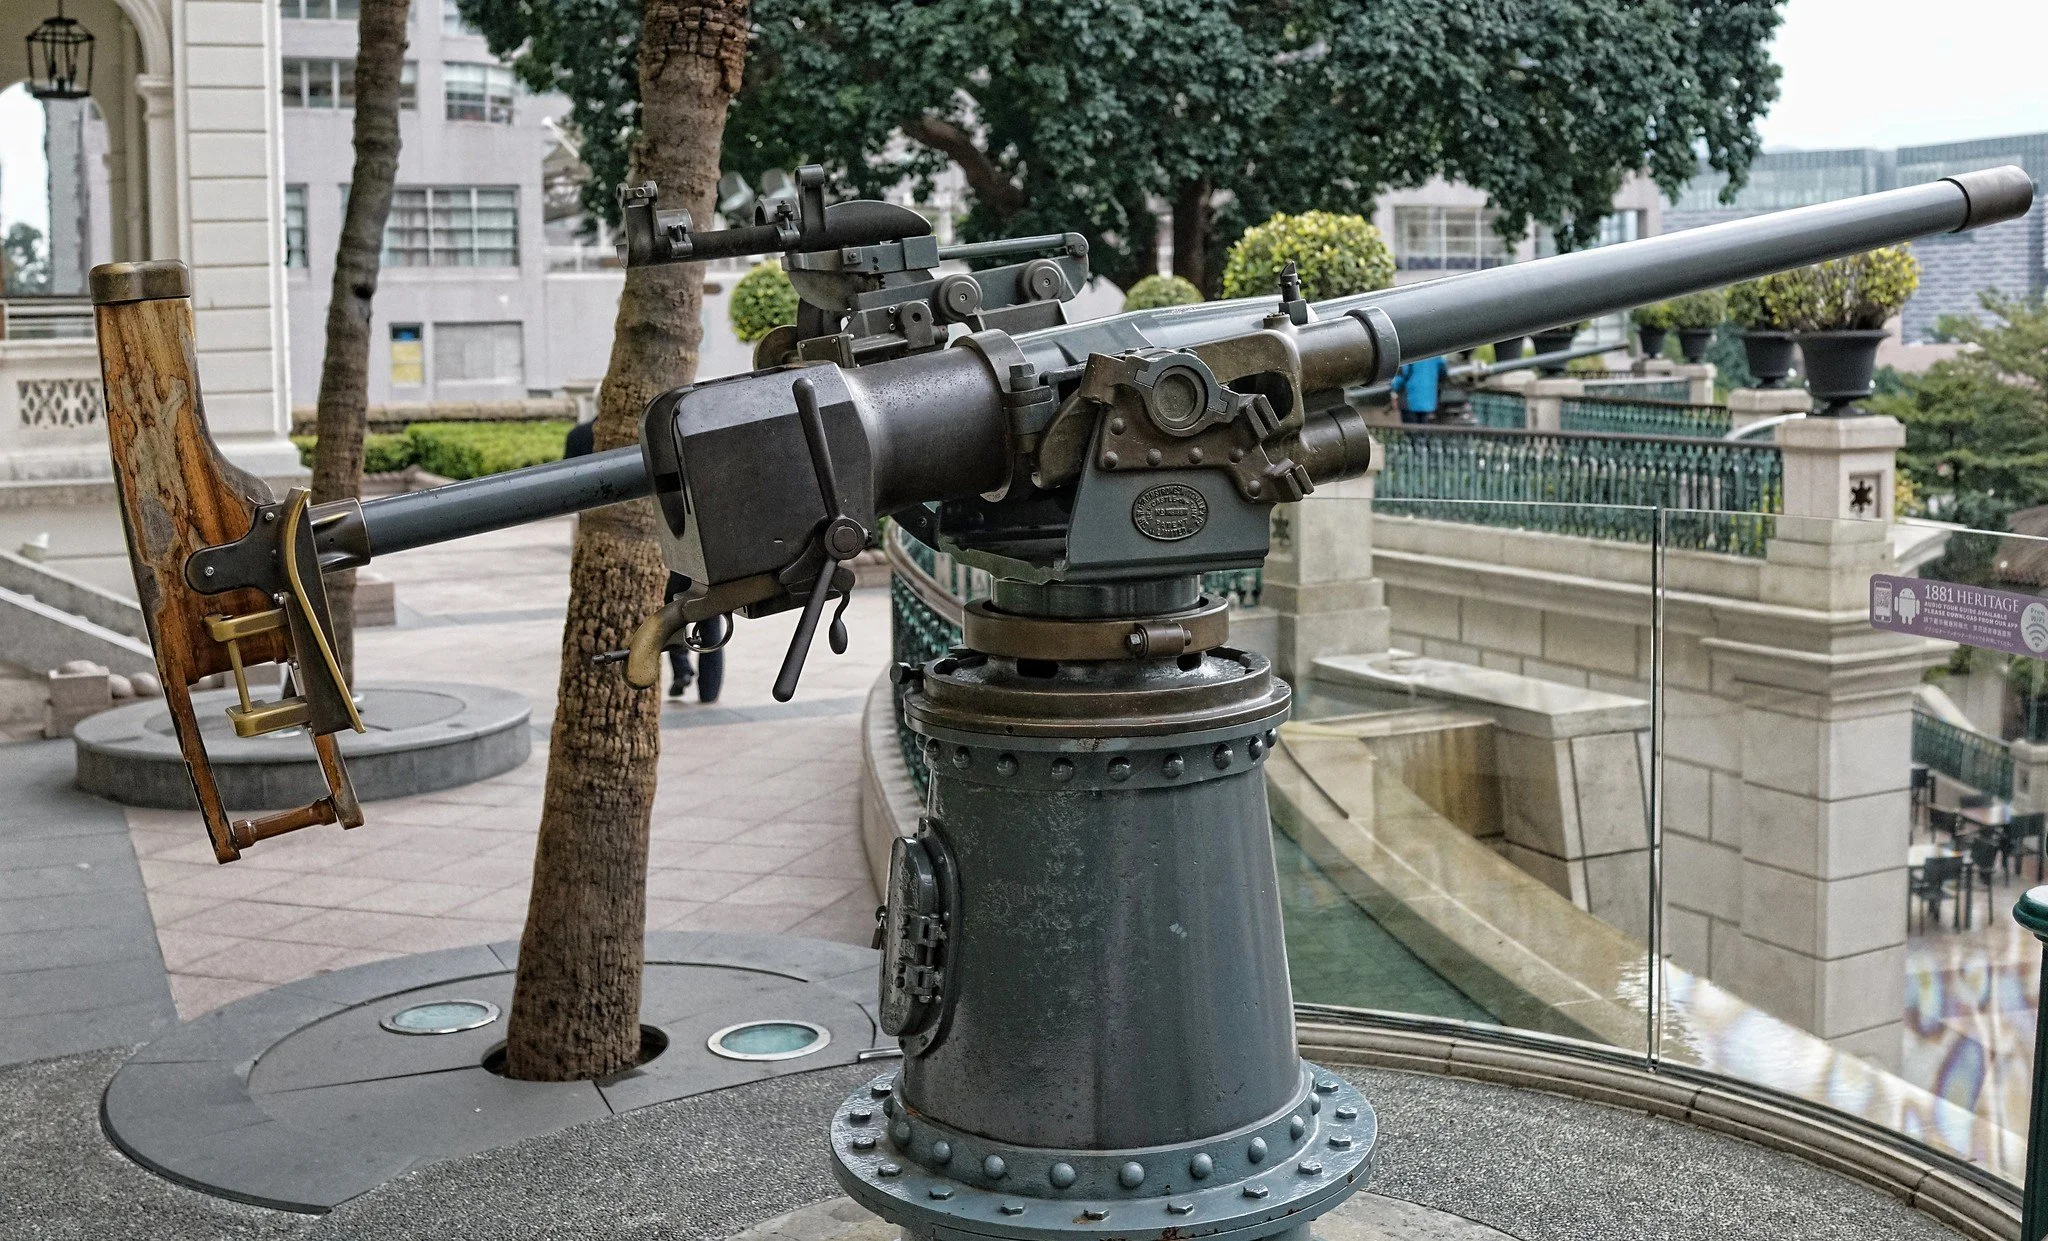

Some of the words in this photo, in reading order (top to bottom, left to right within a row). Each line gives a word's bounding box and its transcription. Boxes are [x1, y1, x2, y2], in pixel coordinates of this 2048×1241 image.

[1156, 517, 1188, 529] PATENT
[1925, 584, 1953, 603] 1881
[1957, 590, 2019, 613] HERITAGE
[1924, 601, 1942, 609] AUDIO
[1943, 603, 1959, 611] TOUR
[1959, 605, 1977, 614] GUIDE
[1977, 610, 2008, 620] AVAILABLE
[1924, 607, 1945, 616] PLEASE
[1946, 611, 1978, 622] DOWNLOAD
[1978, 616, 1994, 625] FROM
[1994, 618, 2007, 627] OUR
[2030, 607, 2046, 616] Free
